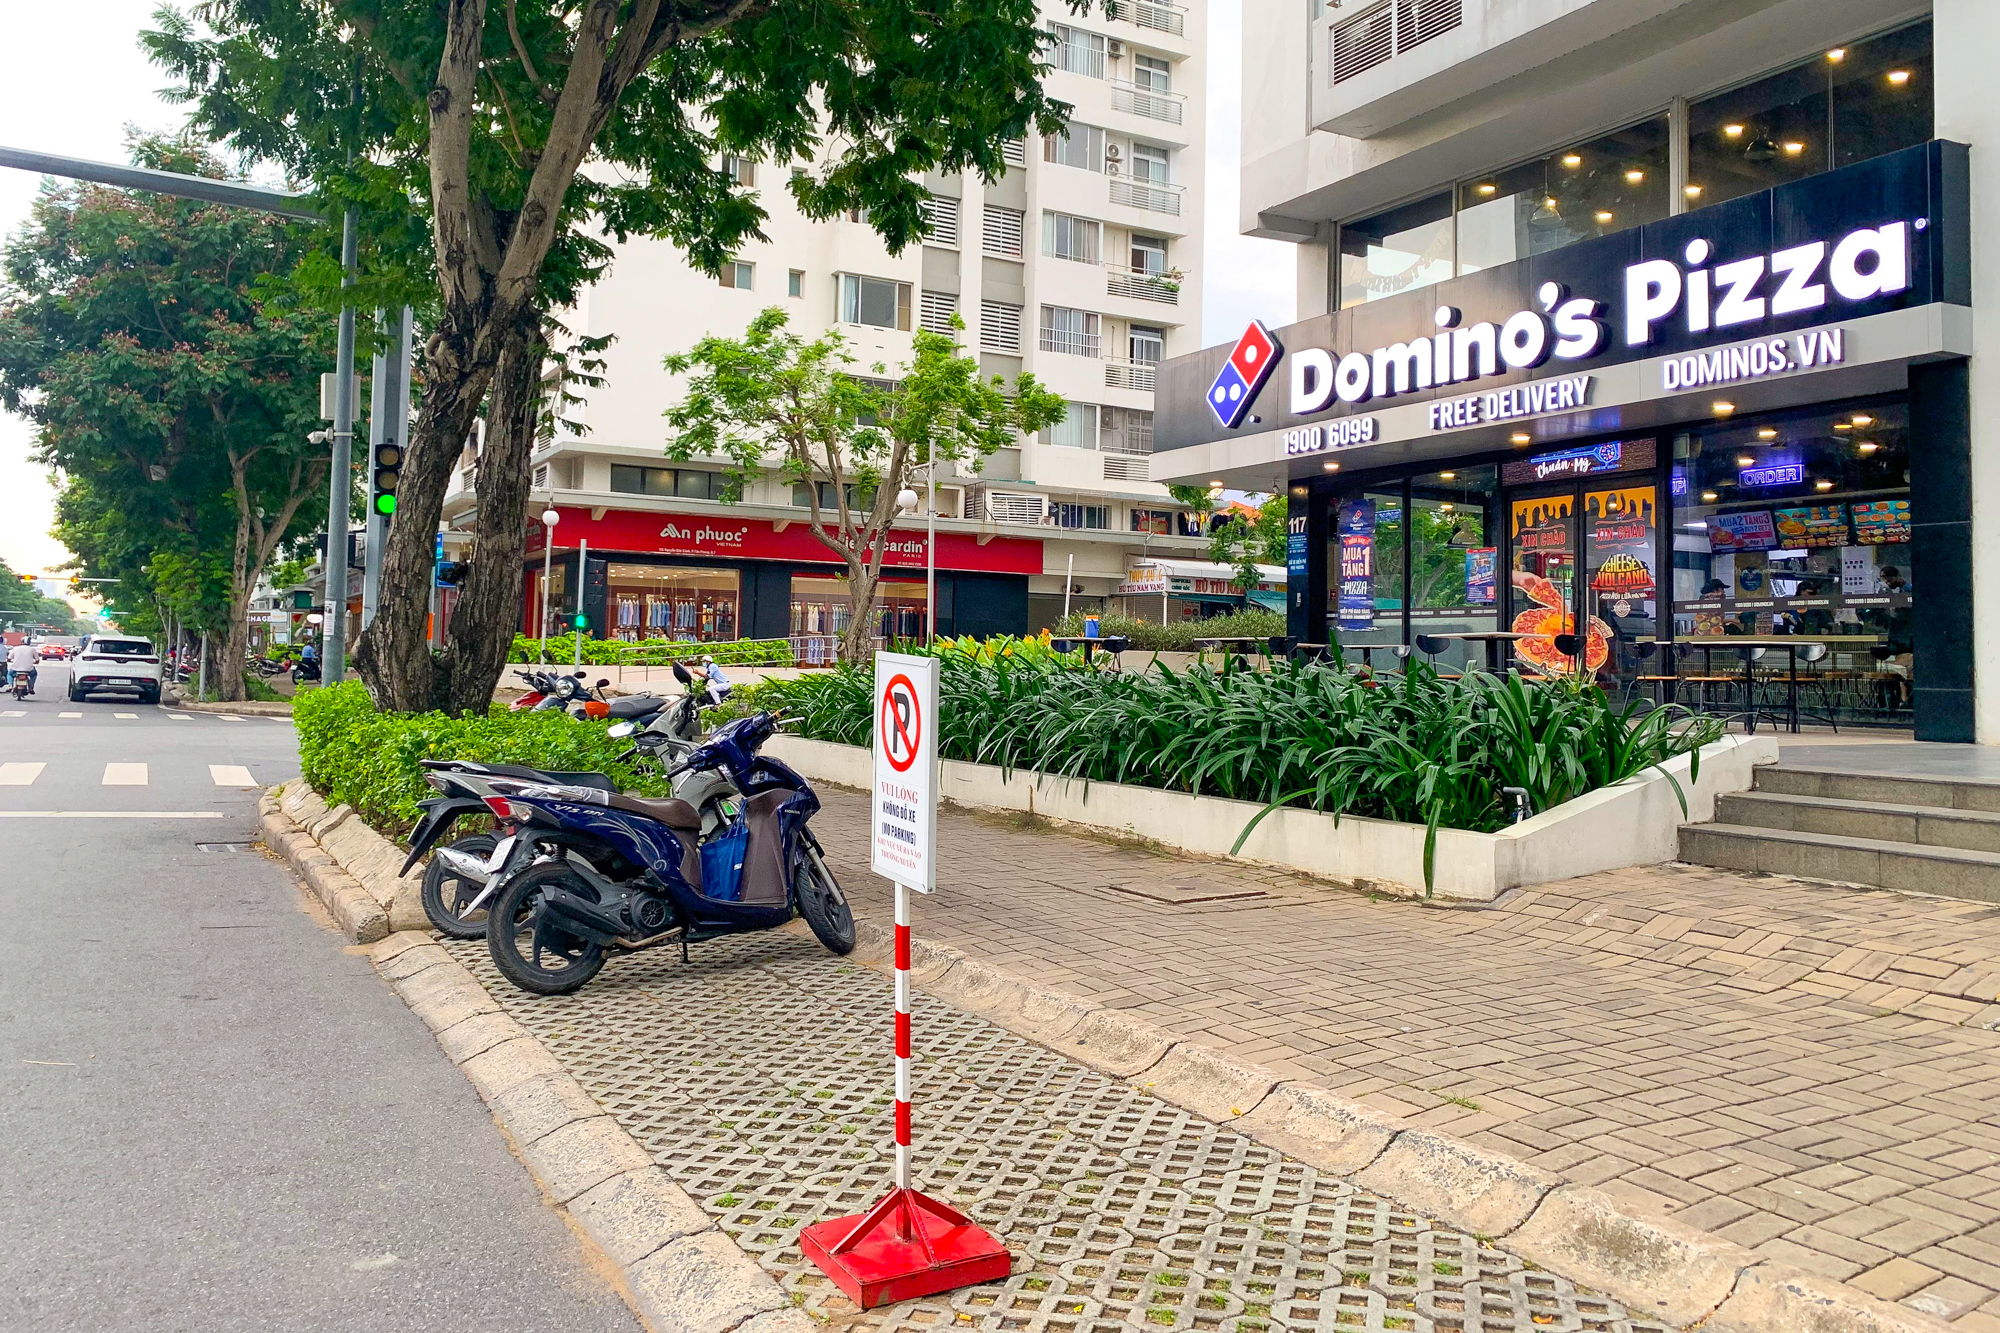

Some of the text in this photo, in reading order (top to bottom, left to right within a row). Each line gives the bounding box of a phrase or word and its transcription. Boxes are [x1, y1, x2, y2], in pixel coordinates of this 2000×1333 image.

[1290, 221, 1908, 414] Domino's Pizza
[1662, 328, 1843, 390] DOMINOS.VN
[1429, 376, 1591, 430] FREE DELIVERY
[1282, 417, 1374, 454] 1900 6099
[1744, 468, 1797, 485] ORDER
[1288, 516, 1307, 534] 117
[1596, 522, 1645, 541] XIN CHÀO
[695, 525, 742, 545] phuoc
[1521, 529, 1566, 547] XIN CHÀO
[883, 540, 923, 554] cardin
[1343, 546, 1371, 576] MUA 1
[1605, 553, 1640, 572] CHEESE
[1597, 568, 1648, 586] VOLCANO
[1137, 583, 1148, 591] NAM
[1344, 581, 1367, 595] PIZZA
[881, 781, 918, 804] VUI LÒNG
[882, 800, 900, 818] KHÔNG
[908, 809, 916, 823] XE
[881, 821, 917, 847] (NO PARKING)
